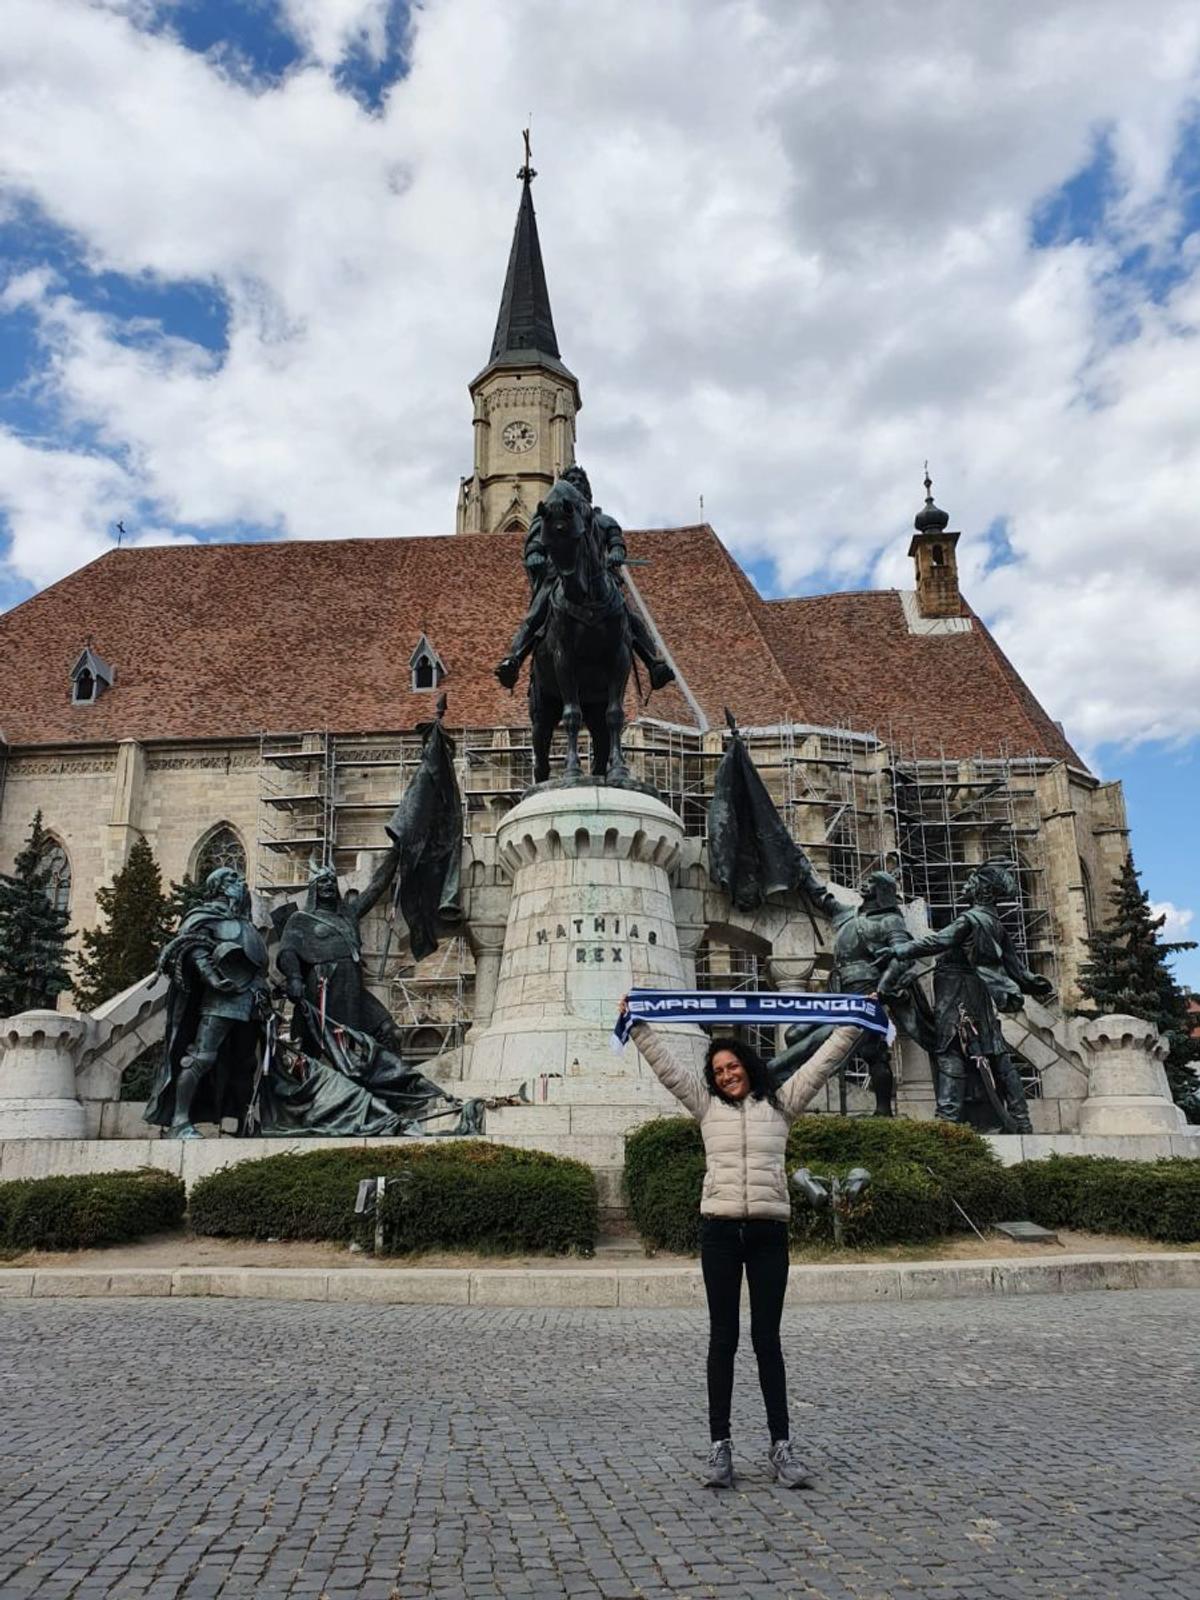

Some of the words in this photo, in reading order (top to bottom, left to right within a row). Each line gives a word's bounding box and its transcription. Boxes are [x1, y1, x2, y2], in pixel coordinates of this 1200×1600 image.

[536, 917, 657, 945] MATHIAS
[576, 947, 622, 963] REX
[628, 998, 717, 1012] EMPRE
[729, 998, 747, 1009] E
